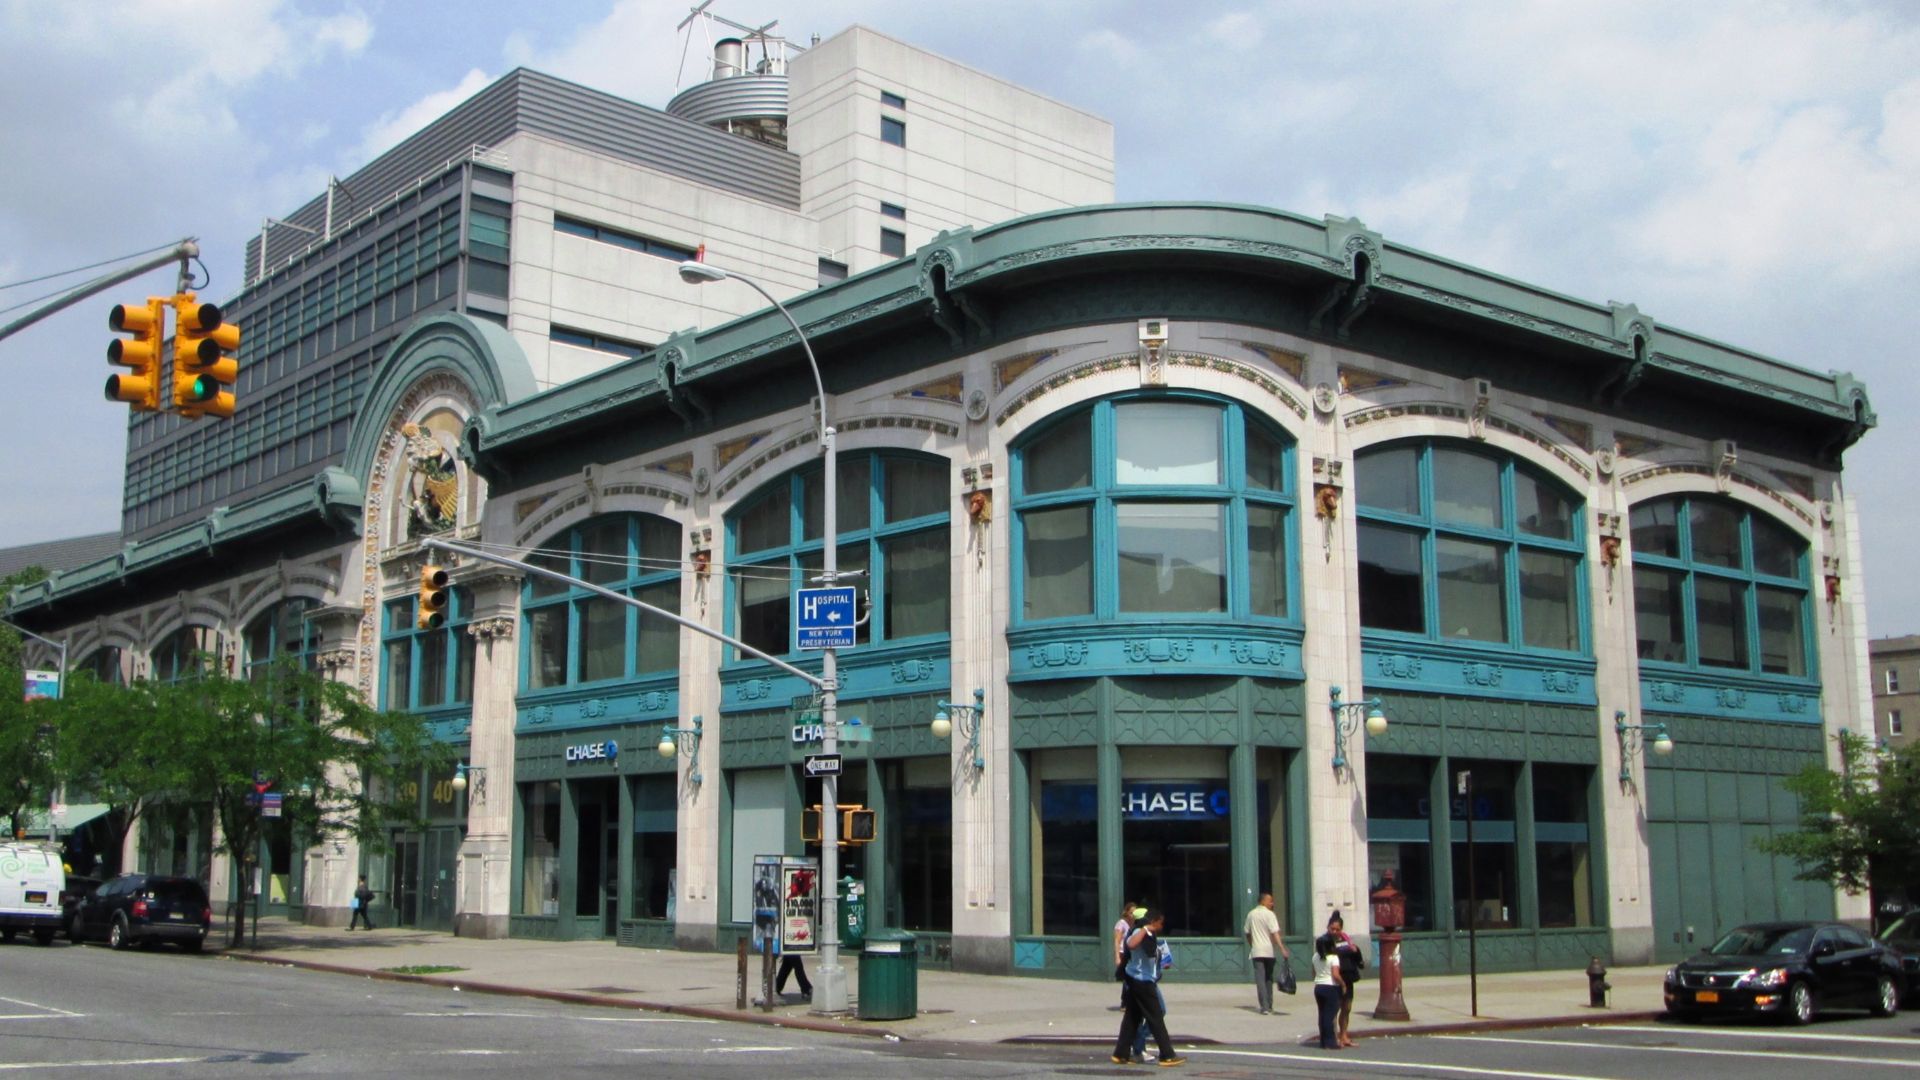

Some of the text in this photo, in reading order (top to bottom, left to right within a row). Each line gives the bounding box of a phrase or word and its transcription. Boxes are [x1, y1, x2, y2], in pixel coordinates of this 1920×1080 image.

[804, 595, 850, 620] HOSPITAL
[825, 629, 843, 637] YORK
[801, 638, 850, 646] PRESBYTERIAN
[566, 743, 606, 761] CHASE
[810, 760, 837, 770] ONE WAY
